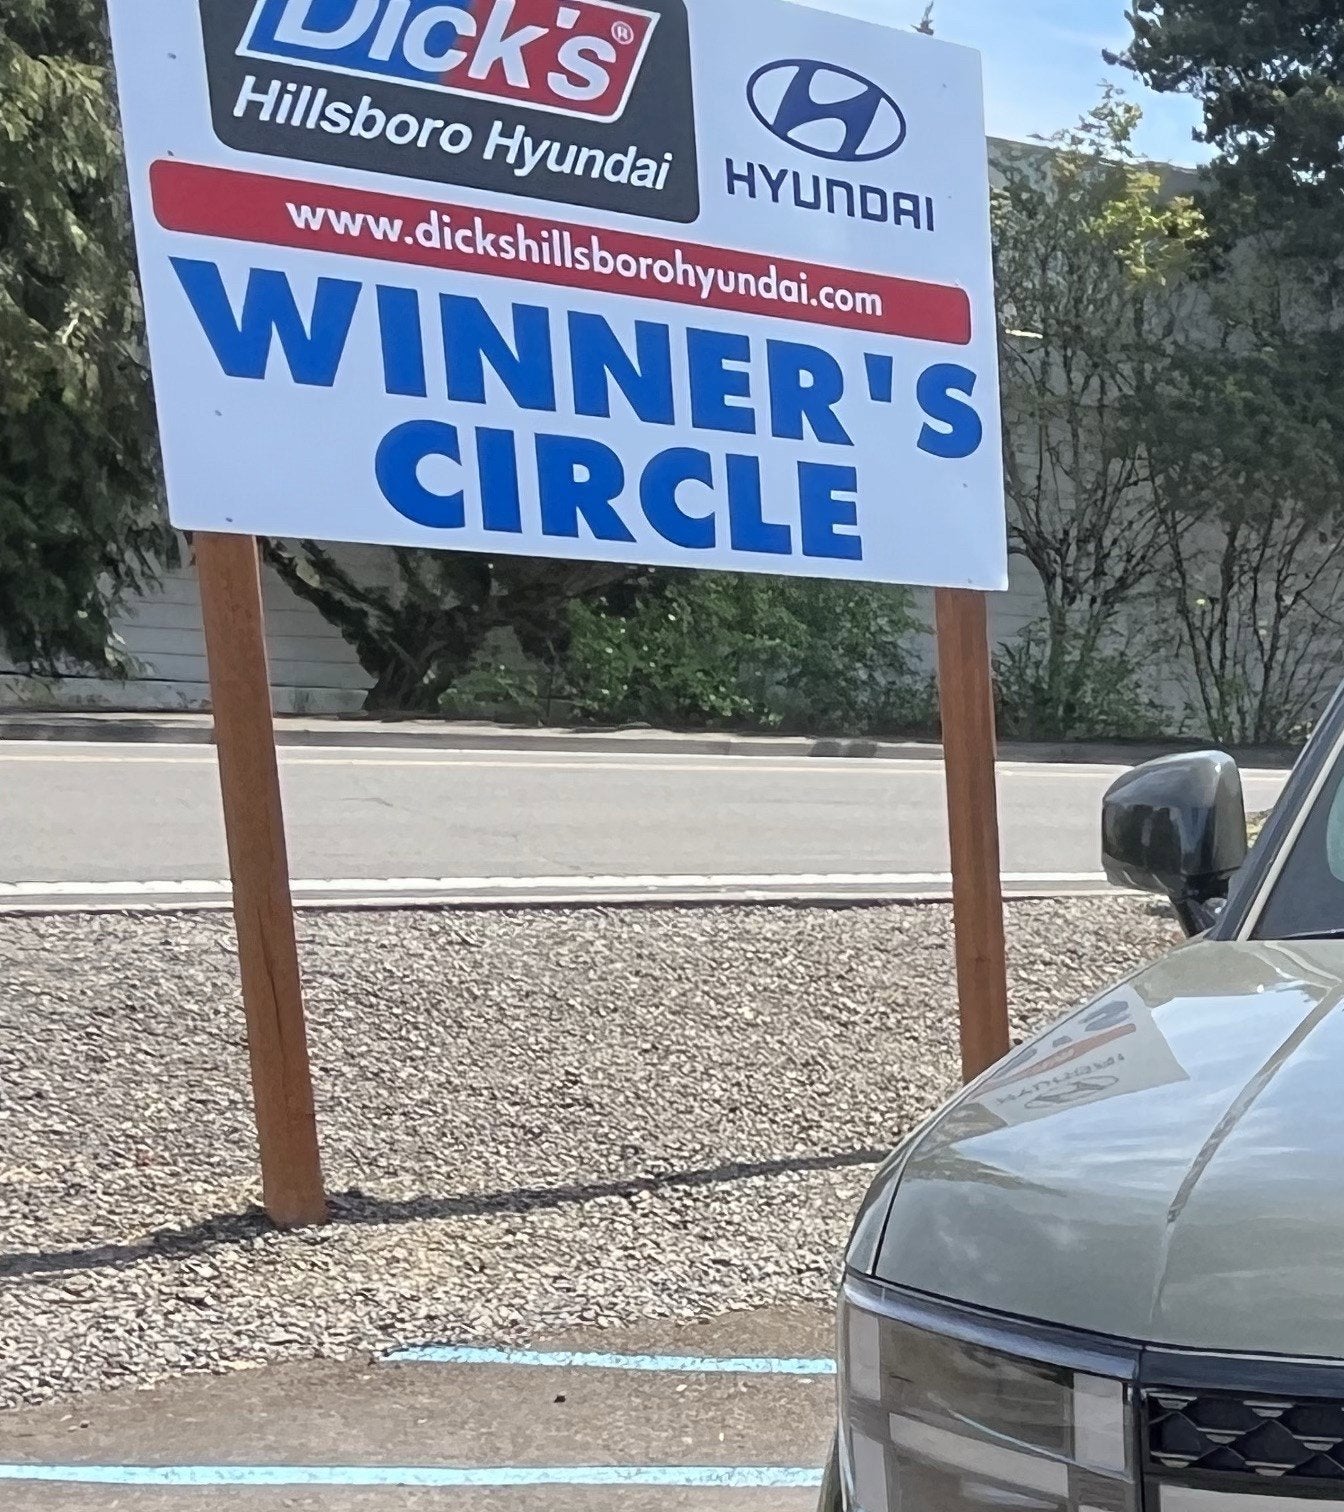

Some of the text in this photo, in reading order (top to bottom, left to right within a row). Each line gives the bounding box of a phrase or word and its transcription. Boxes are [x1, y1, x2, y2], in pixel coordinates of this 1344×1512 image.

[273, 0, 617, 101] Dick's
[233, 75, 674, 191] Hillsboro Hyundai
[725, 157, 936, 232] HYUNDAI
[284, 200, 884, 319] www.dickshillsborohyundai.com
[168, 255, 983, 460] WINNER'S
[374, 418, 864, 562] CIRCLE
